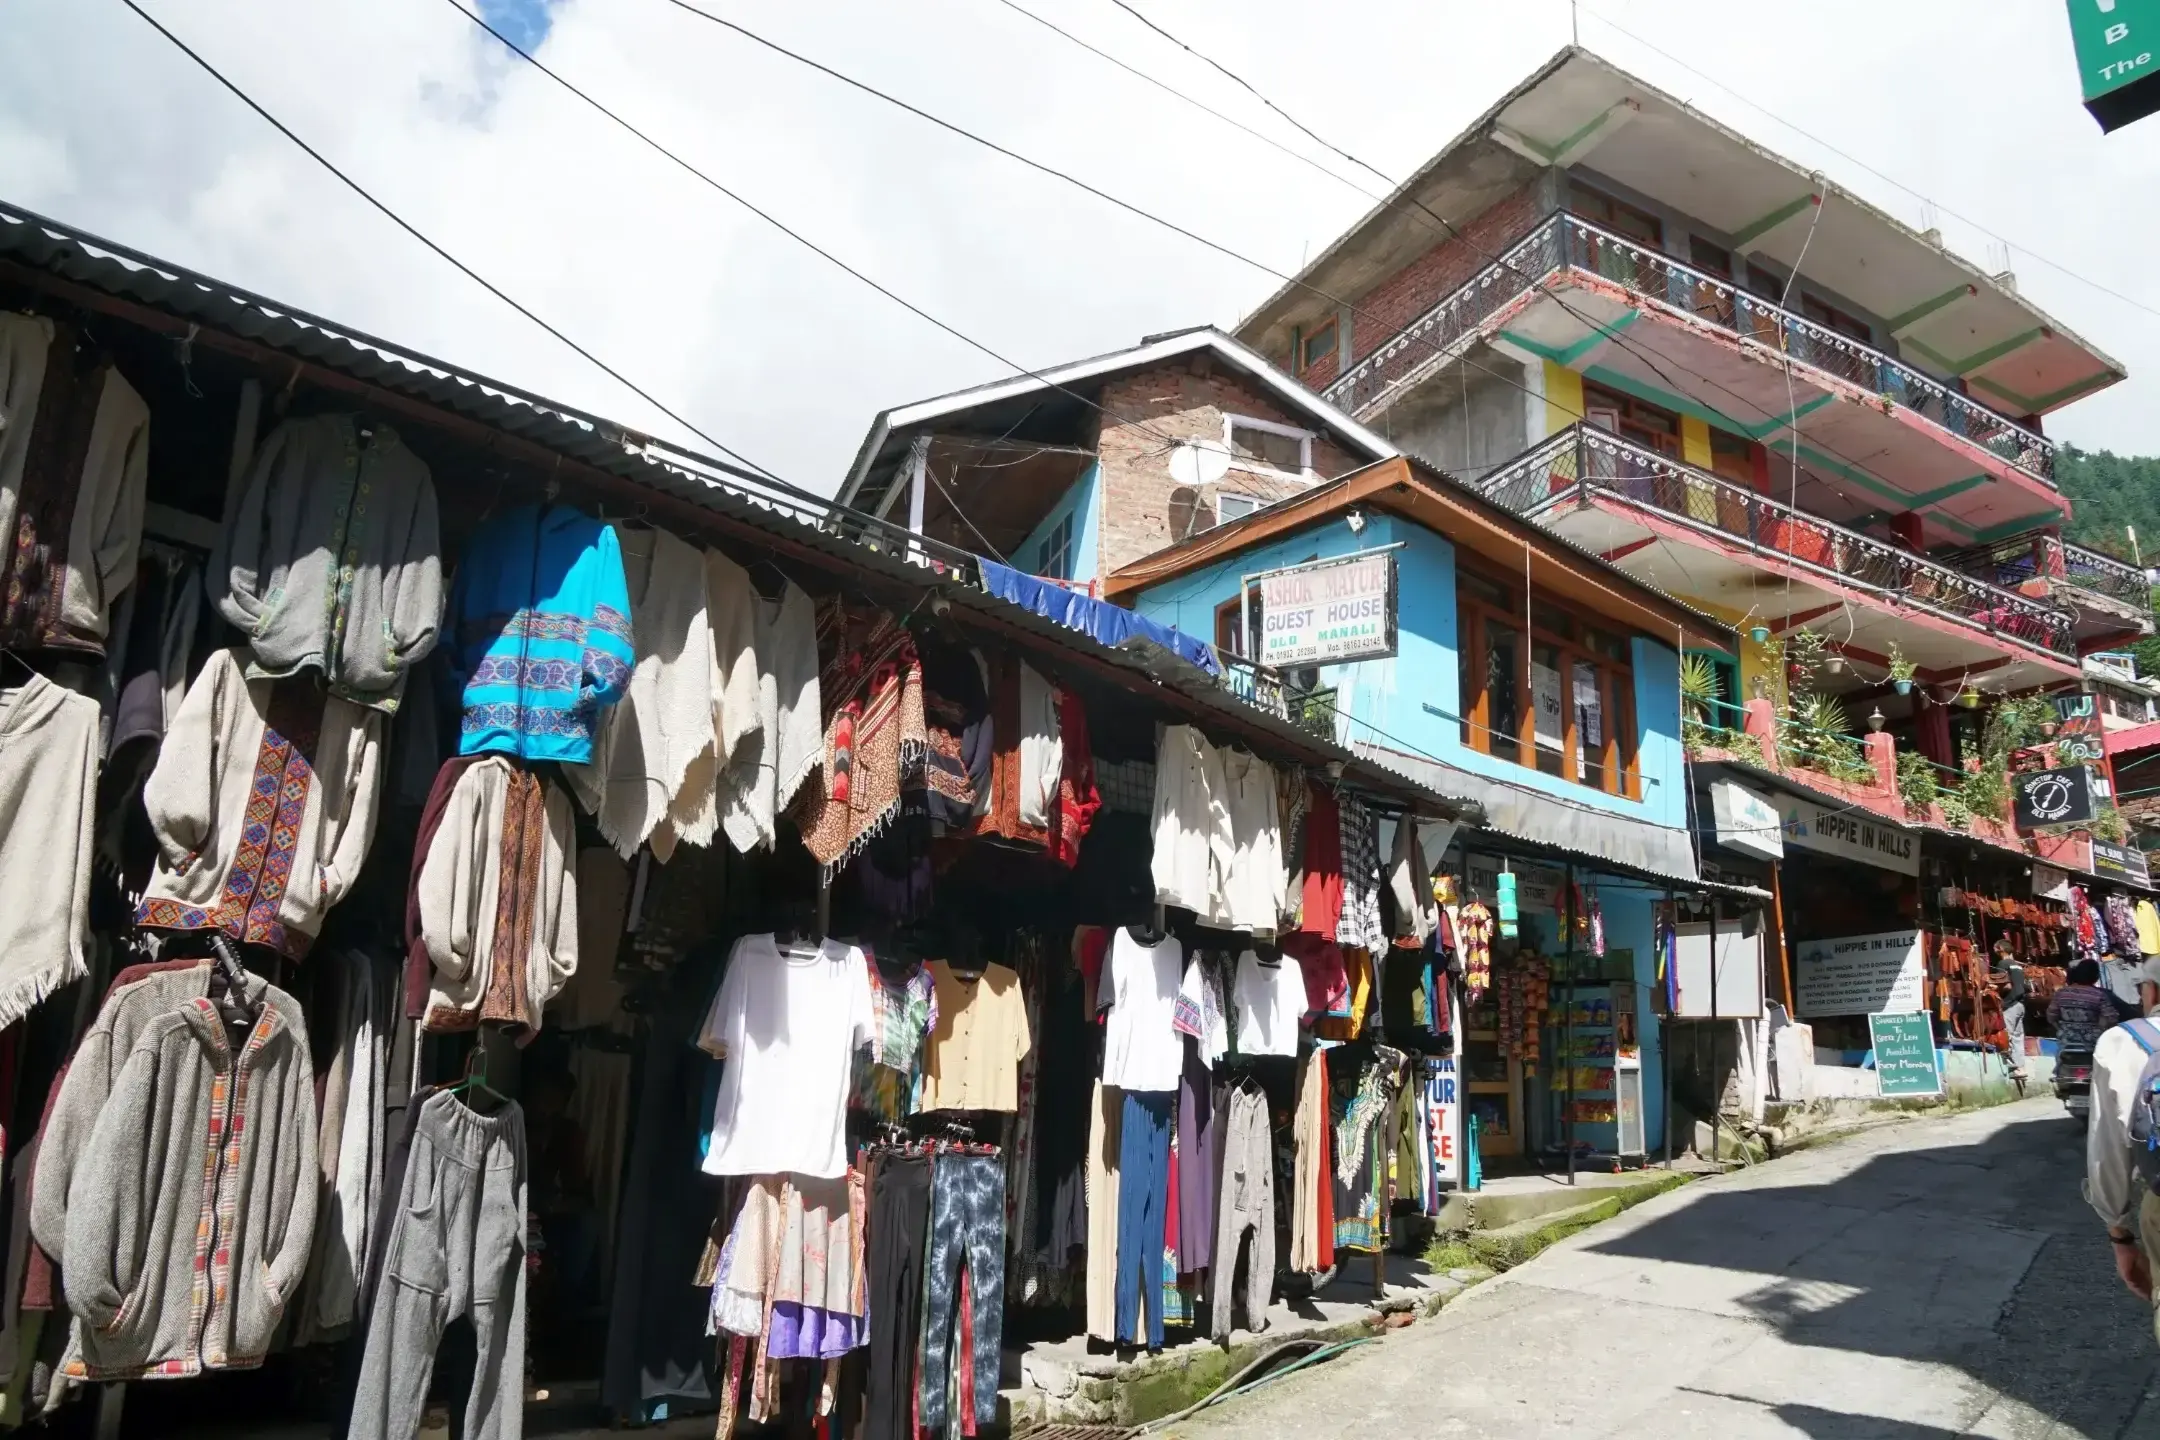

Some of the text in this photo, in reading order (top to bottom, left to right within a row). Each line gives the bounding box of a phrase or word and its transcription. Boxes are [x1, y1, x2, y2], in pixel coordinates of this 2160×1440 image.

[2098, 52, 2151, 81] The
[1266, 563, 1381, 608] ASHOK MAYUR
[1266, 598, 1381, 632] GUEST HOUSE
[1270, 623, 1376, 648] OLD MANALI
[2024, 774, 2074, 794] NONSTOP CAFE
[2031, 804, 2072, 820] OLD MANALI
[1815, 811, 1912, 860] HIPPIE IN HILLS
[1834, 936, 1915, 954] HIPPIE IN HILLS
[1871, 960, 1901, 968] BOOKINGS
[1900, 1059, 1932, 1072] Morning
[1425, 1078, 1455, 1104] YUR
